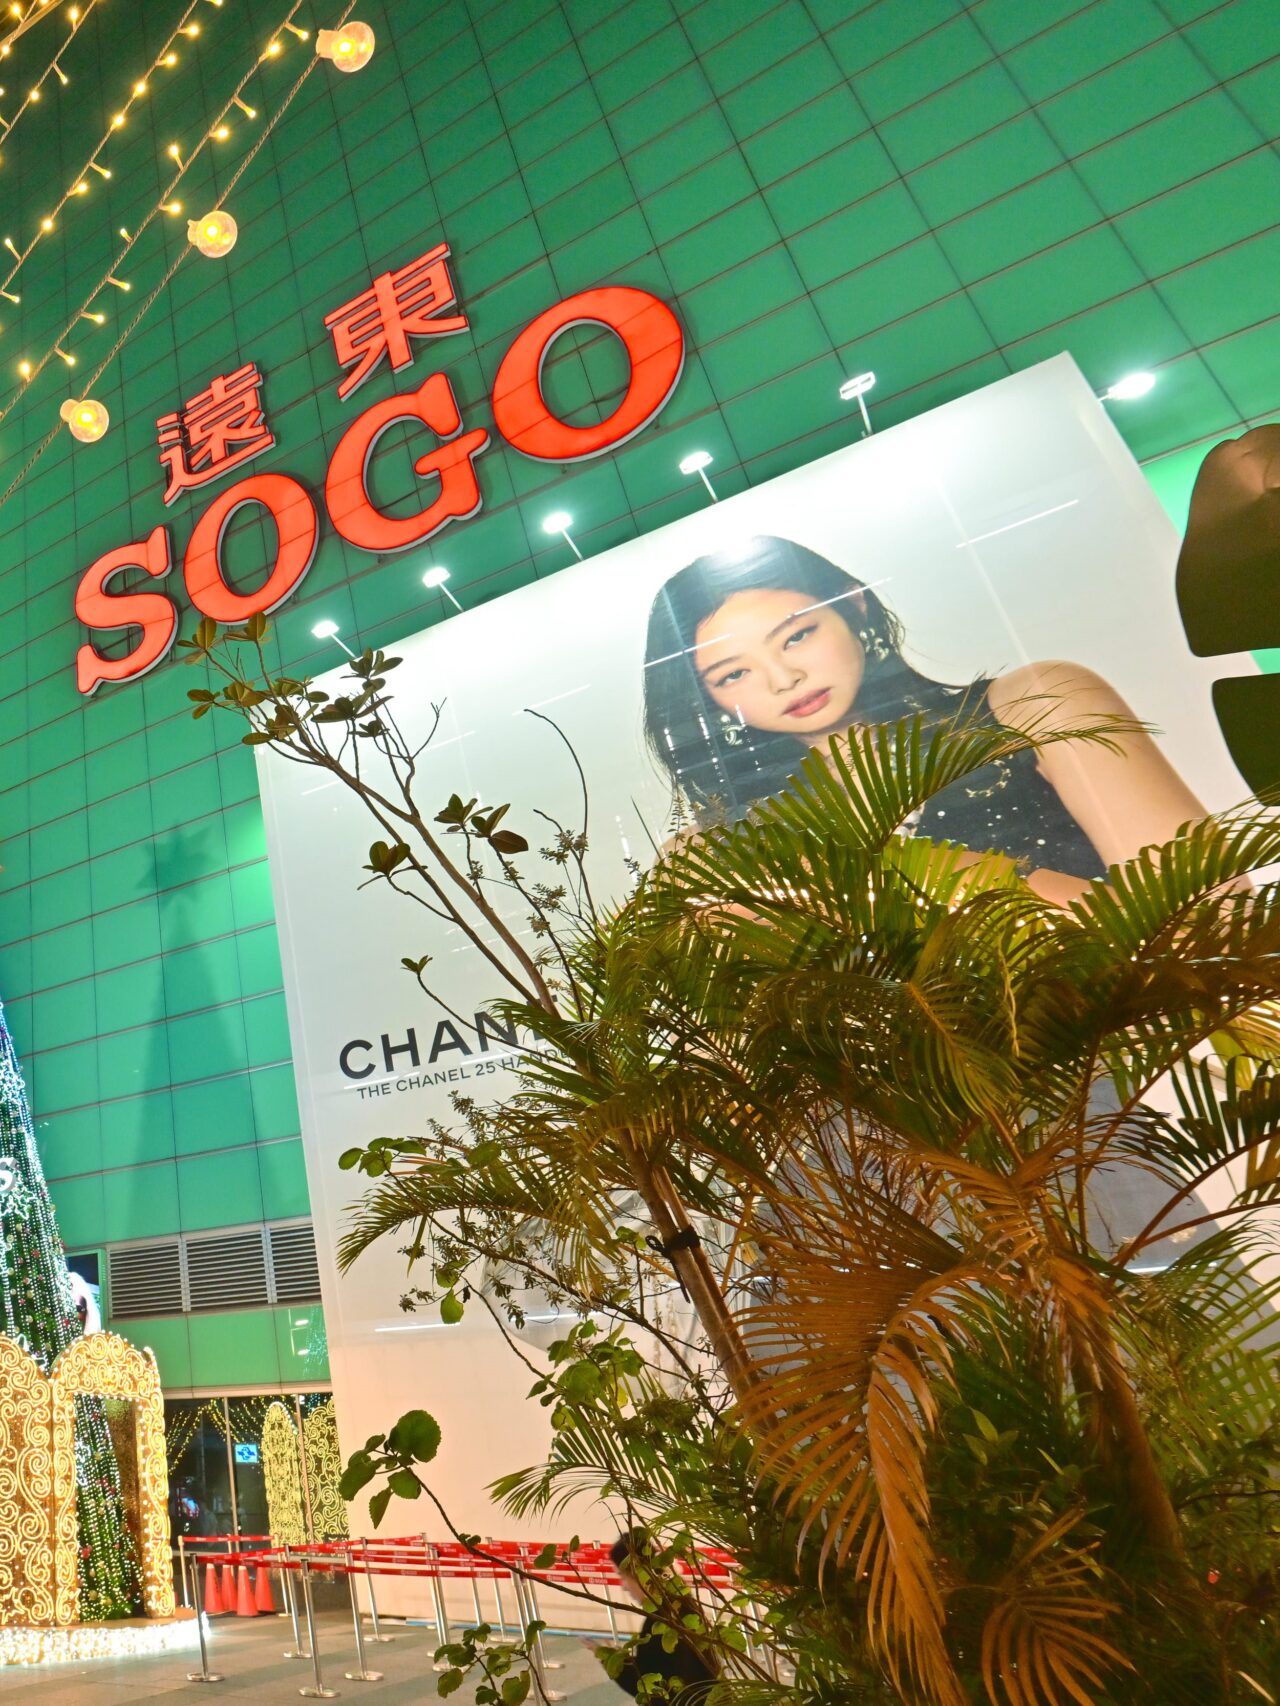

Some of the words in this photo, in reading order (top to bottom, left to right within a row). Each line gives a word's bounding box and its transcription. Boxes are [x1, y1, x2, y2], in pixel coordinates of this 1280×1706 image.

[156, 241, 469, 506] 遠東
[75, 285, 685, 696] SOGO
[339, 994, 558, 1080] CHAN
[357, 1082, 391, 1099] THE
[396, 1067, 471, 1092] CHANEL
[475, 1061, 496, 1077] 25
